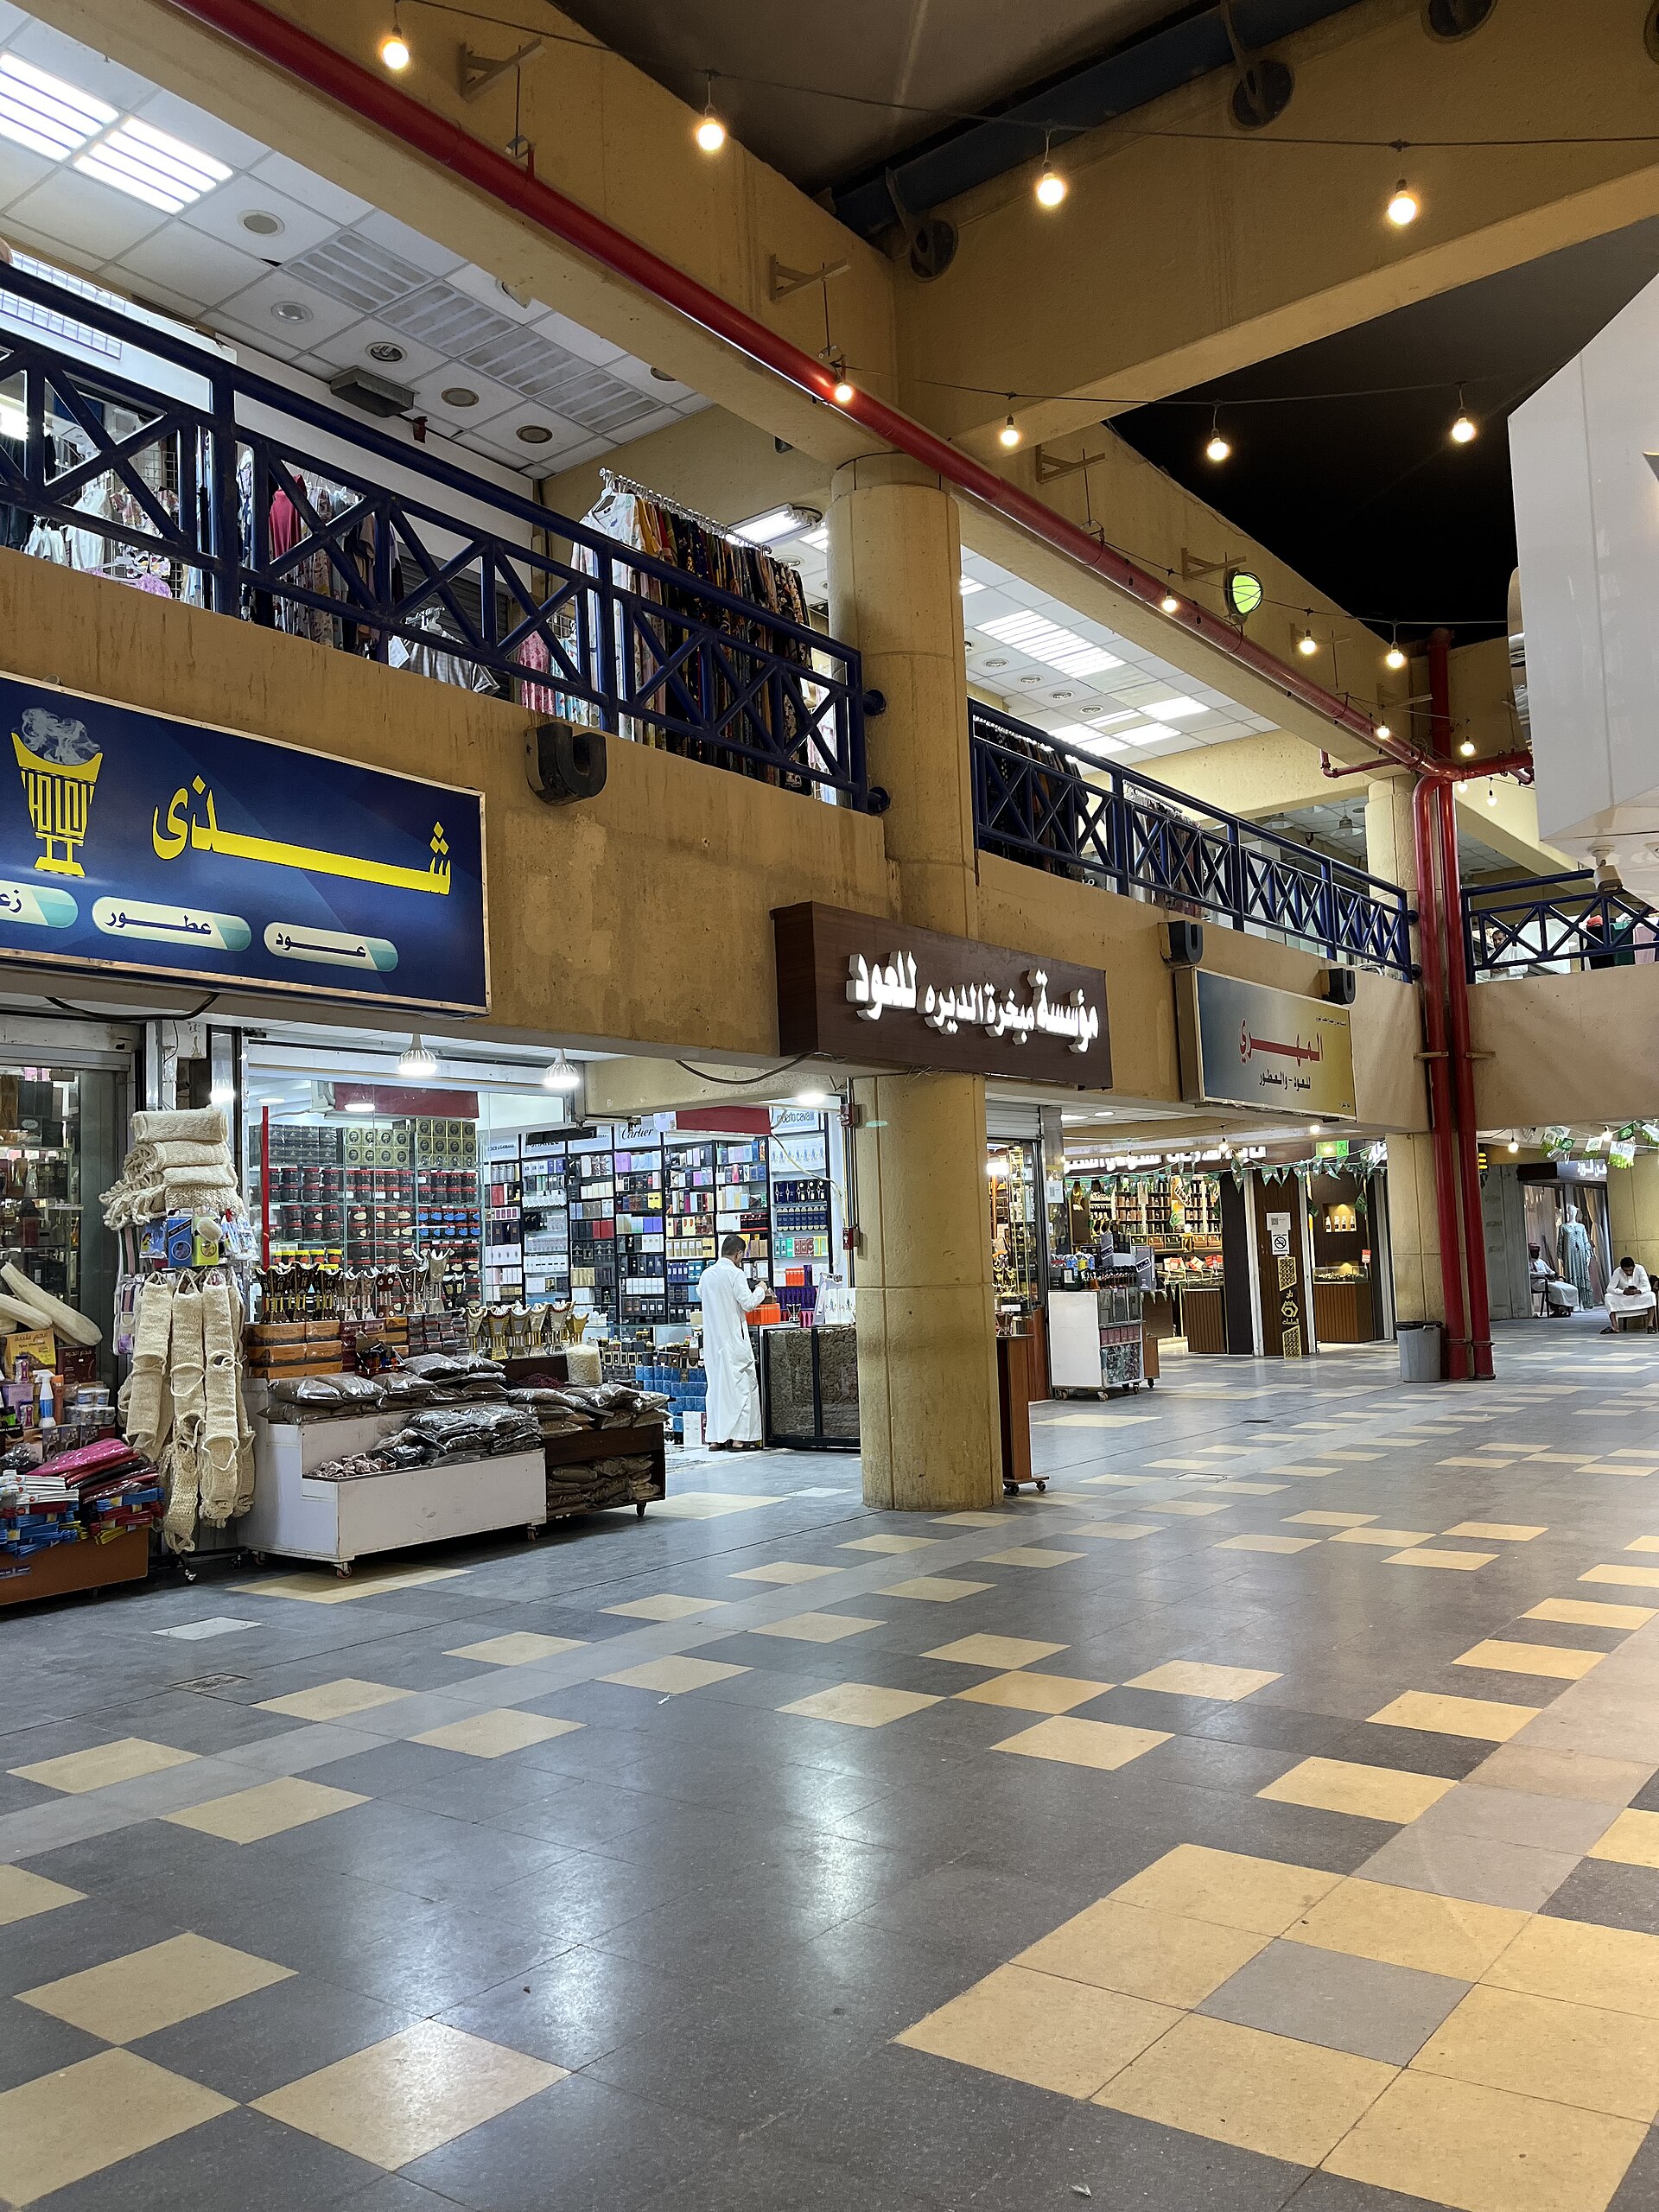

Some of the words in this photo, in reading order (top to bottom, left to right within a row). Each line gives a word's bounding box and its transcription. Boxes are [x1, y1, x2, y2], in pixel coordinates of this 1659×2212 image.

[105, 915, 213, 936] عطور
[276, 931, 367, 958] عود
[846, 950, 918, 1020] للعود
[985, 982, 1035, 1045] مبخرة
[1027, 968, 1099, 1053] مؤسسة
[622, 1128, 654, 1140] Cartier
